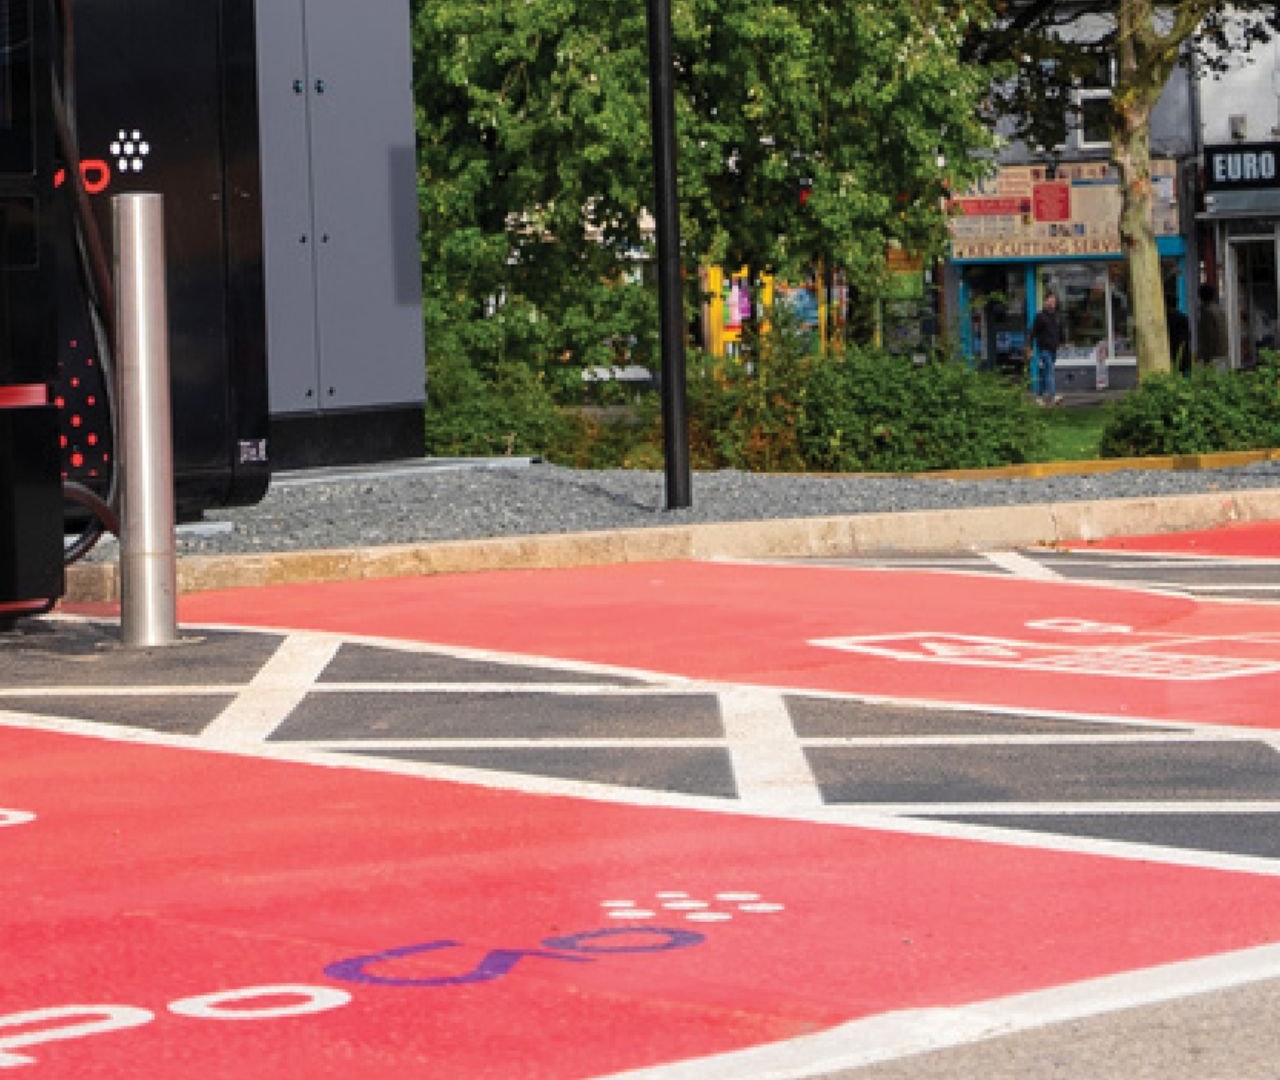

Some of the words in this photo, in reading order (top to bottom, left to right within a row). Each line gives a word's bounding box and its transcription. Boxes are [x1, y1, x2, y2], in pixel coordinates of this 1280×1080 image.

[1213, 152, 1276, 182] EURO
[967, 243, 997, 259] KEY
[999, 239, 1070, 258] CUTTING
[1073, 236, 1120, 255] SERV
